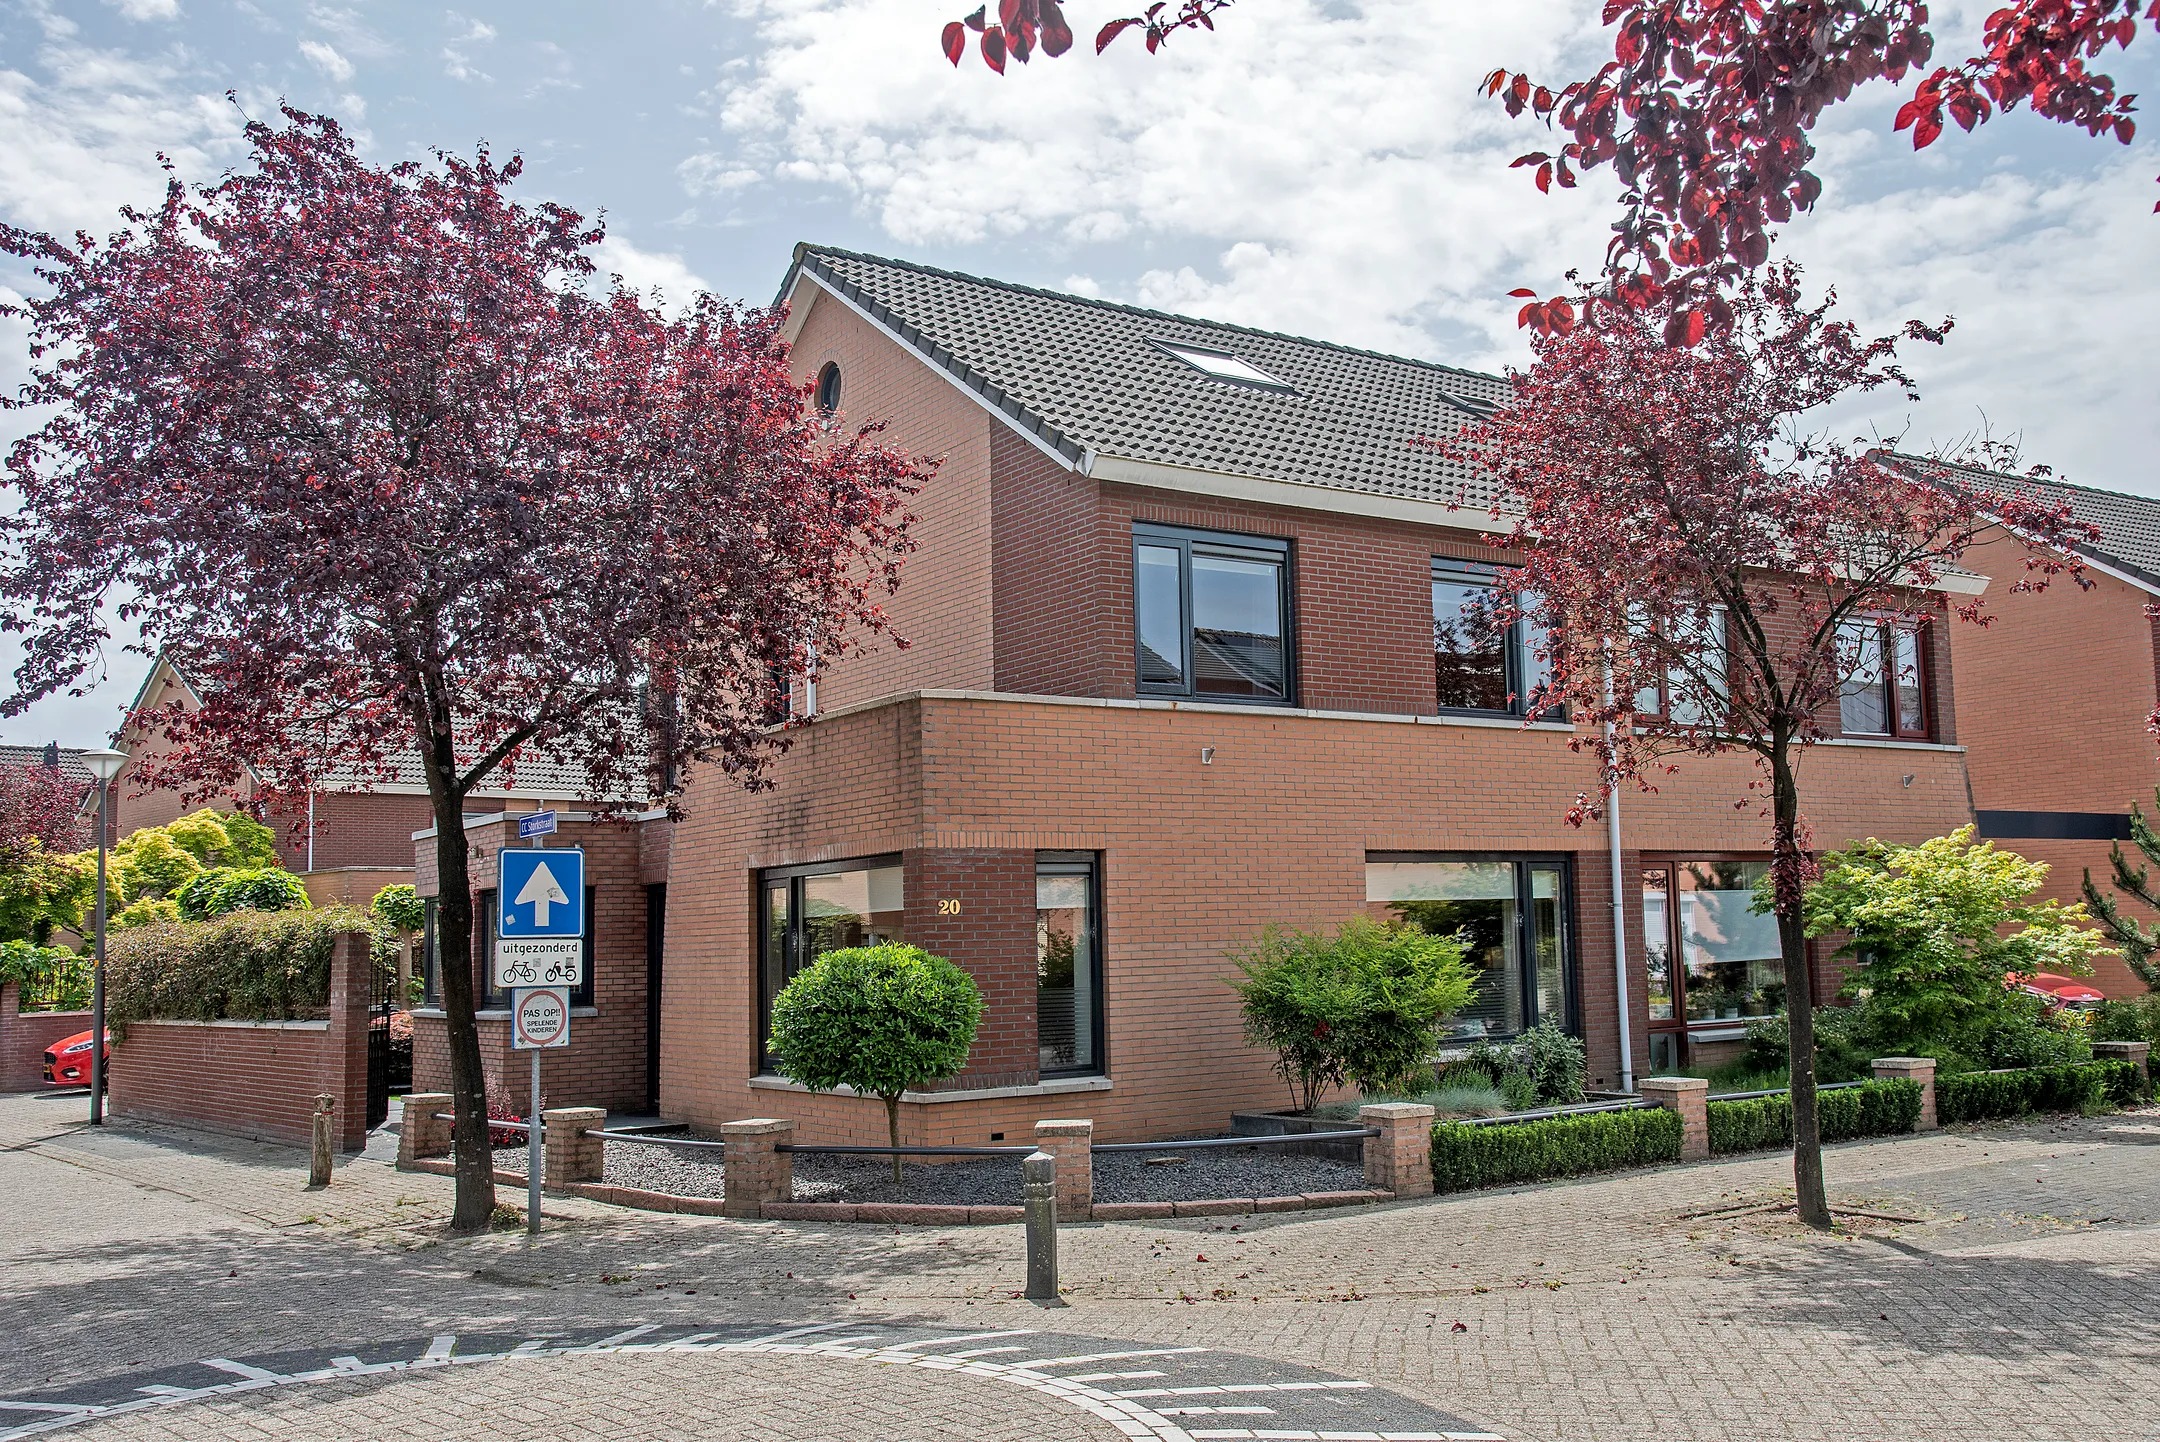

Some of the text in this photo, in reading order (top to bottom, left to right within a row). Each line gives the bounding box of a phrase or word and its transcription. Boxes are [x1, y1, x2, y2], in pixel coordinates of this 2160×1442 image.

[938, 899, 961, 915] 20
[503, 942, 578, 956] uitgezonderd
[523, 1008, 560, 1017] PAS OP!!
